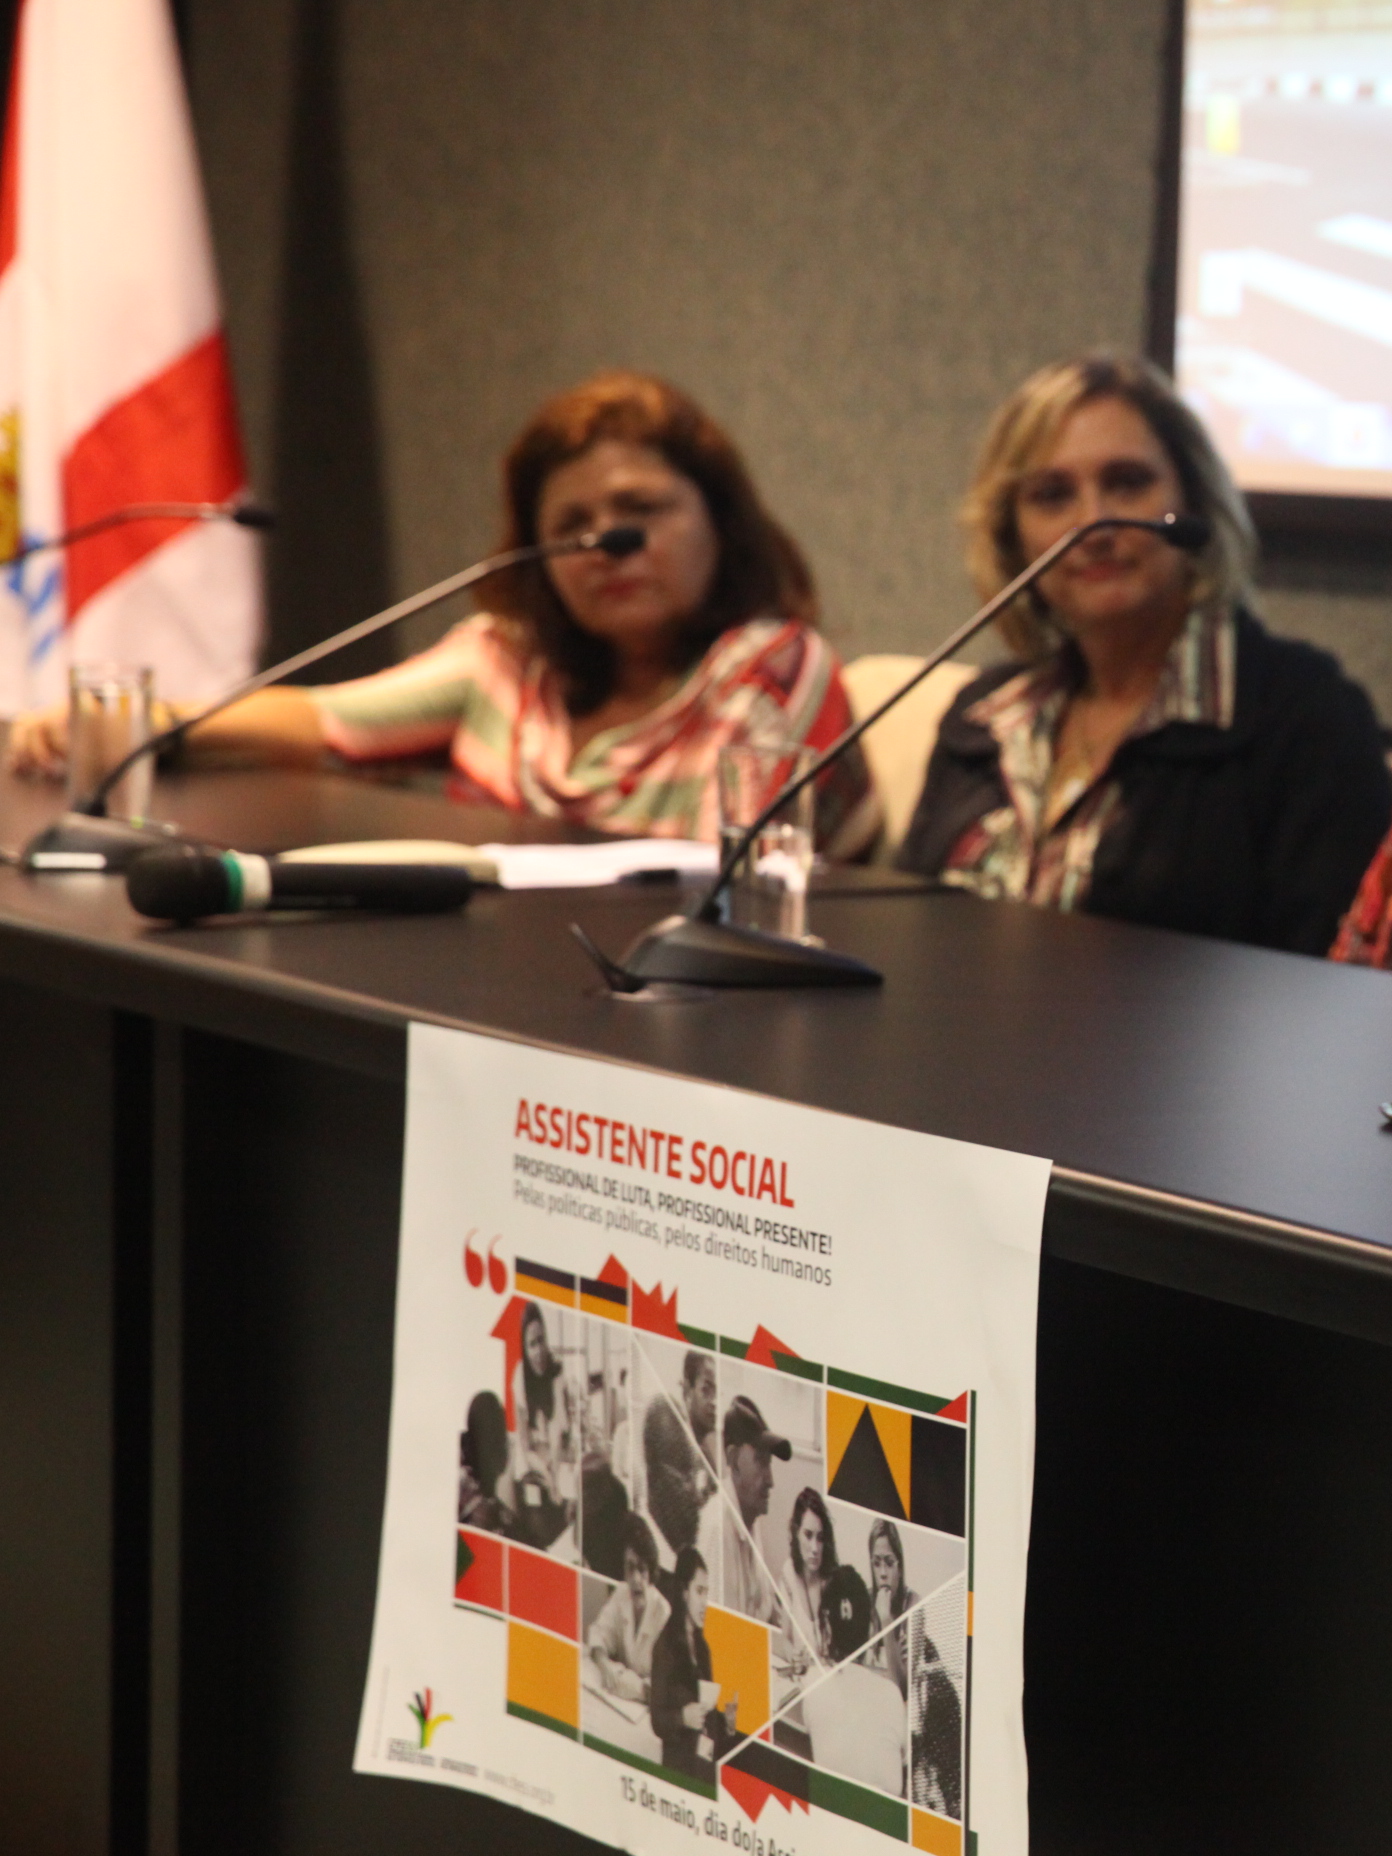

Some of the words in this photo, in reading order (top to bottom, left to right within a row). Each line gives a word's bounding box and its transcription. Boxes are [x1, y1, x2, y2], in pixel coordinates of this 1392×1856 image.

[514, 1097, 683, 1180] ASSISTENTE
[689, 1140, 795, 1208] SOCIAL
[513, 1153, 599, 1194] PROFISSIONAL
[603, 1177, 619, 1199] DE
[621, 1183, 656, 1213] LUTA,
[657, 1192, 751, 1235] PROFISSIONAL
[755, 1217, 832, 1256] PRESENTE!
[664, 1223, 701, 1251] pelos
[705, 1231, 757, 1267] direitos
[761, 1245, 832, 1286] humanos
[620, 1775, 636, 1802] 15
[640, 1782, 656, 1812] de
[660, 1799, 699, 1836] maio,
[704, 1809, 728, 1842] dia
